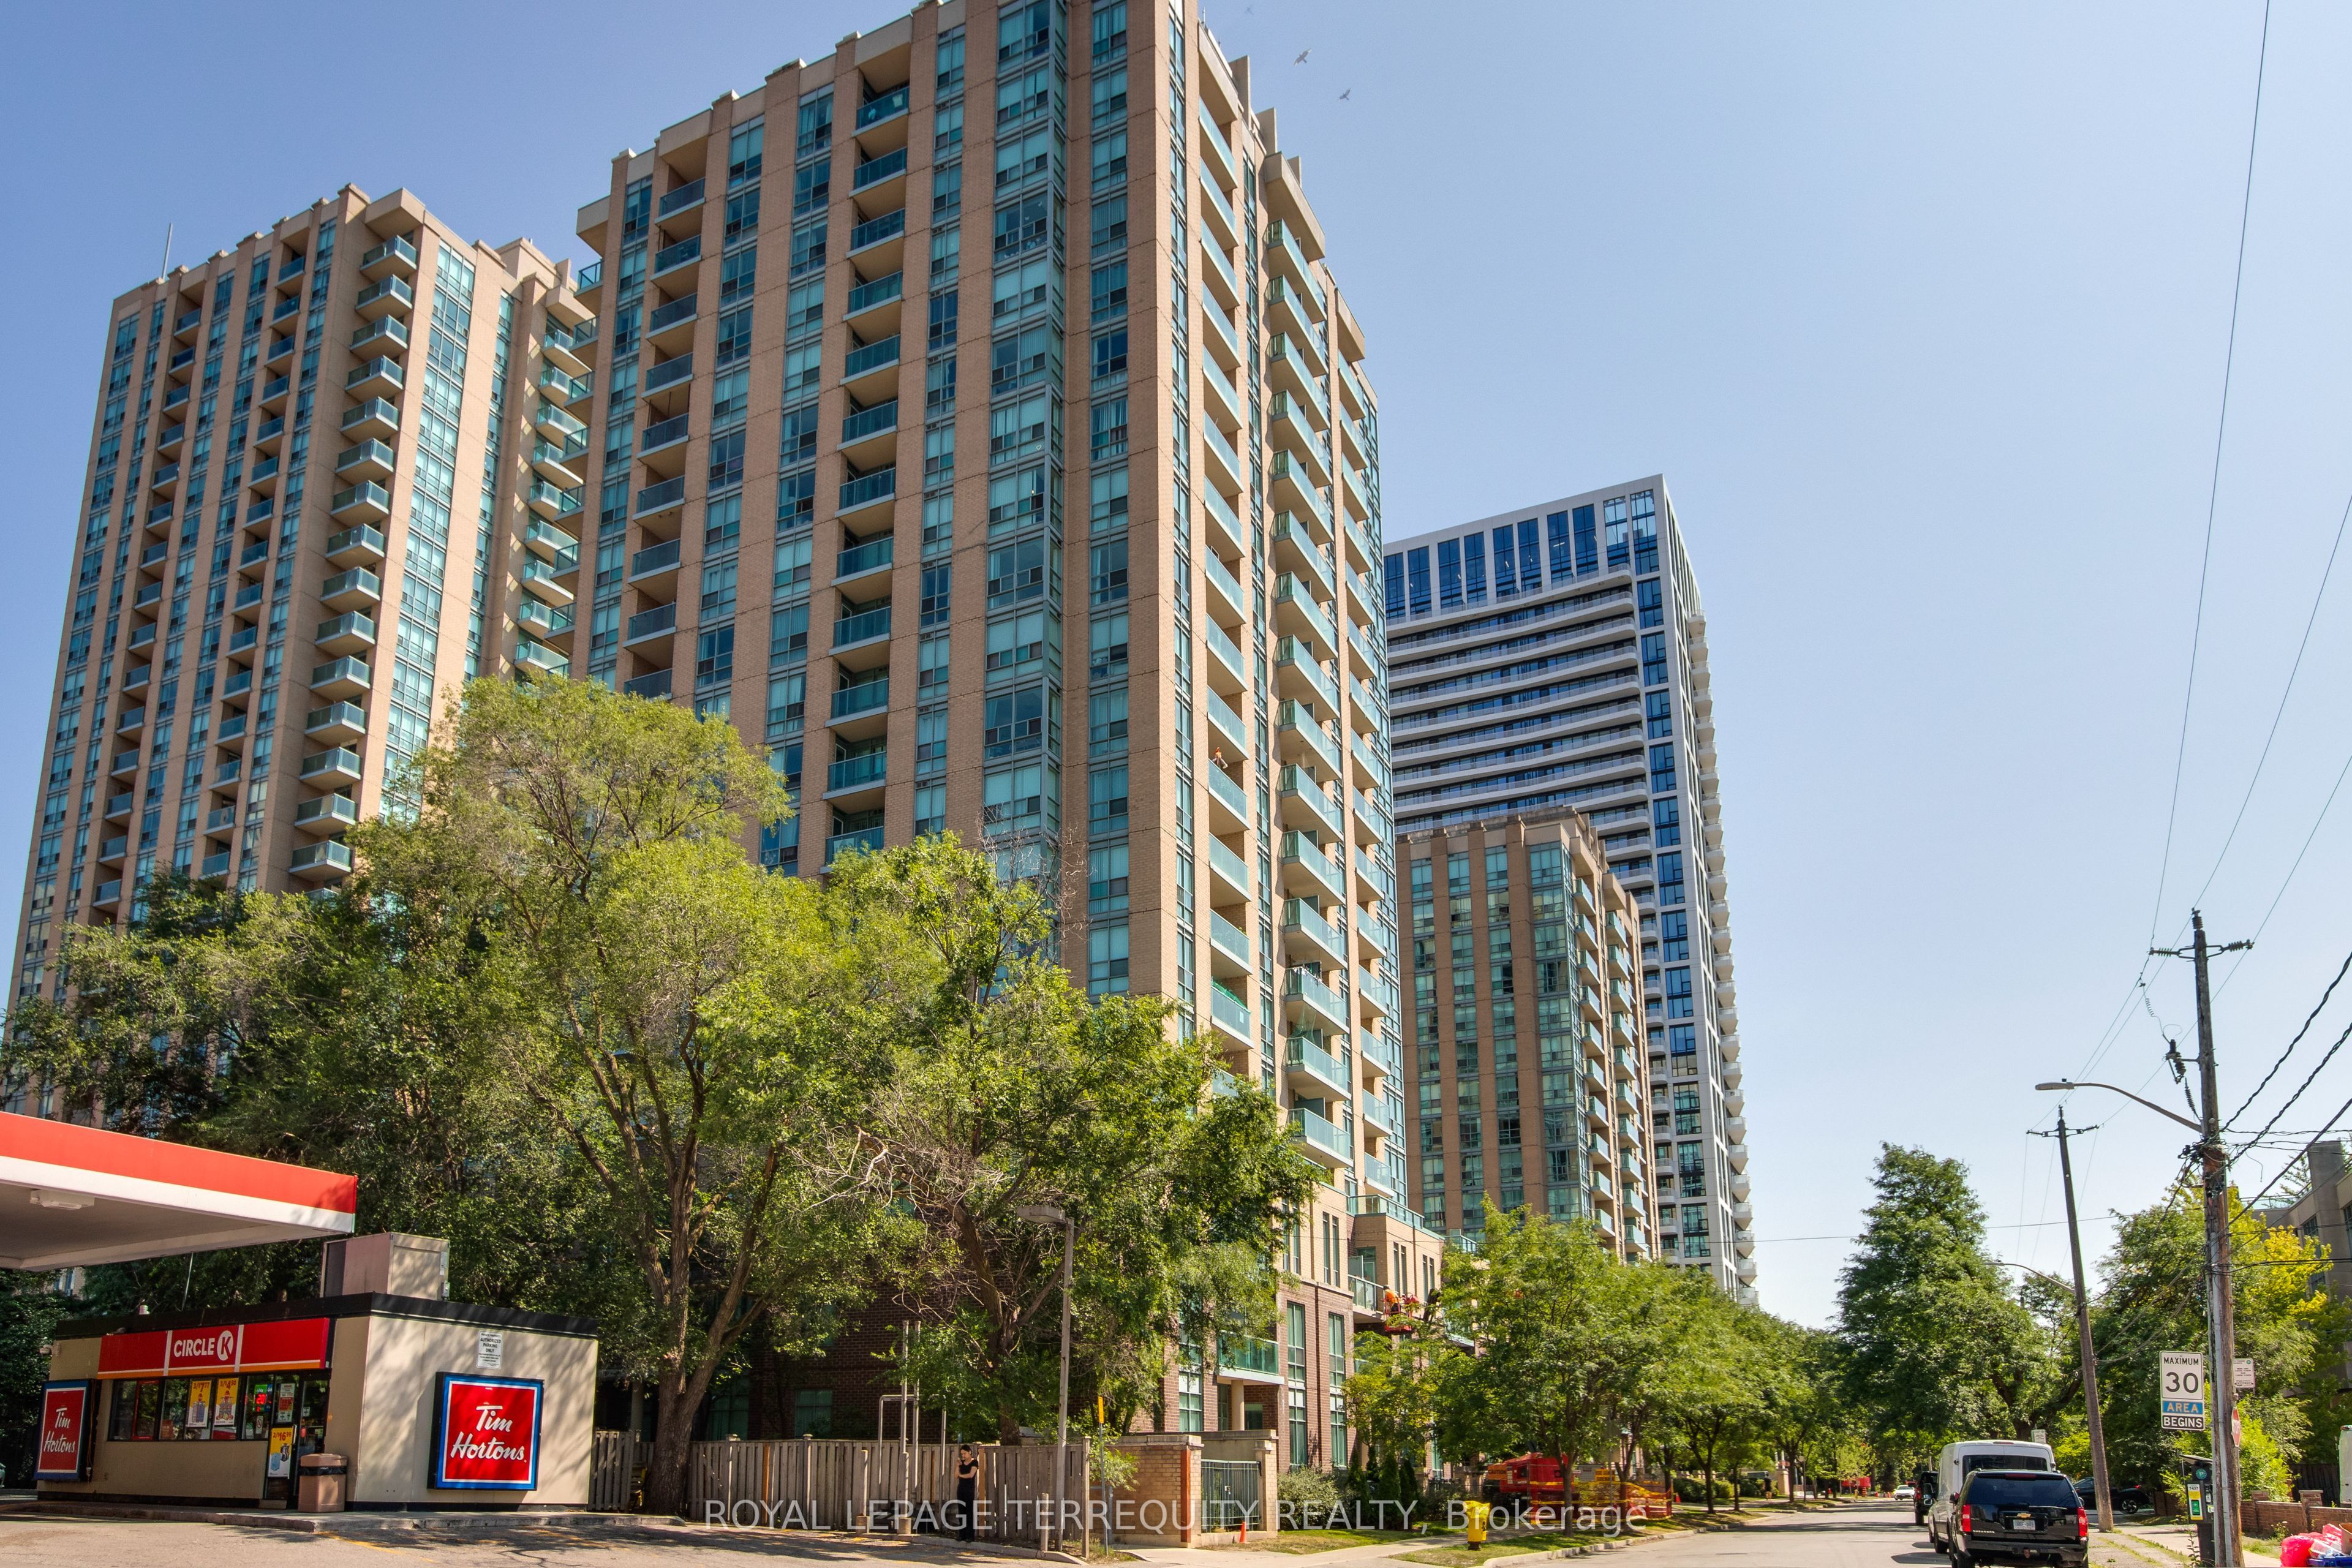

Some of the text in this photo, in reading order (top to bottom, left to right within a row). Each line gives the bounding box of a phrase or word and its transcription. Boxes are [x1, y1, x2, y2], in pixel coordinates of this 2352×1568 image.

[173, 1338, 214, 1357] CIRCLE
[2163, 1357, 2199, 1365] MAXIMUM
[2165, 1372, 2199, 1393] 30
[2166, 1402, 2199, 1413] AREA
[55, 1408, 70, 1428] Tim
[476, 1405, 513, 1433] Tim
[2163, 1417, 2203, 1428] BEGINS
[43, 1430, 75, 1453] Hortons
[450, 1431, 525, 1460] Hortons
